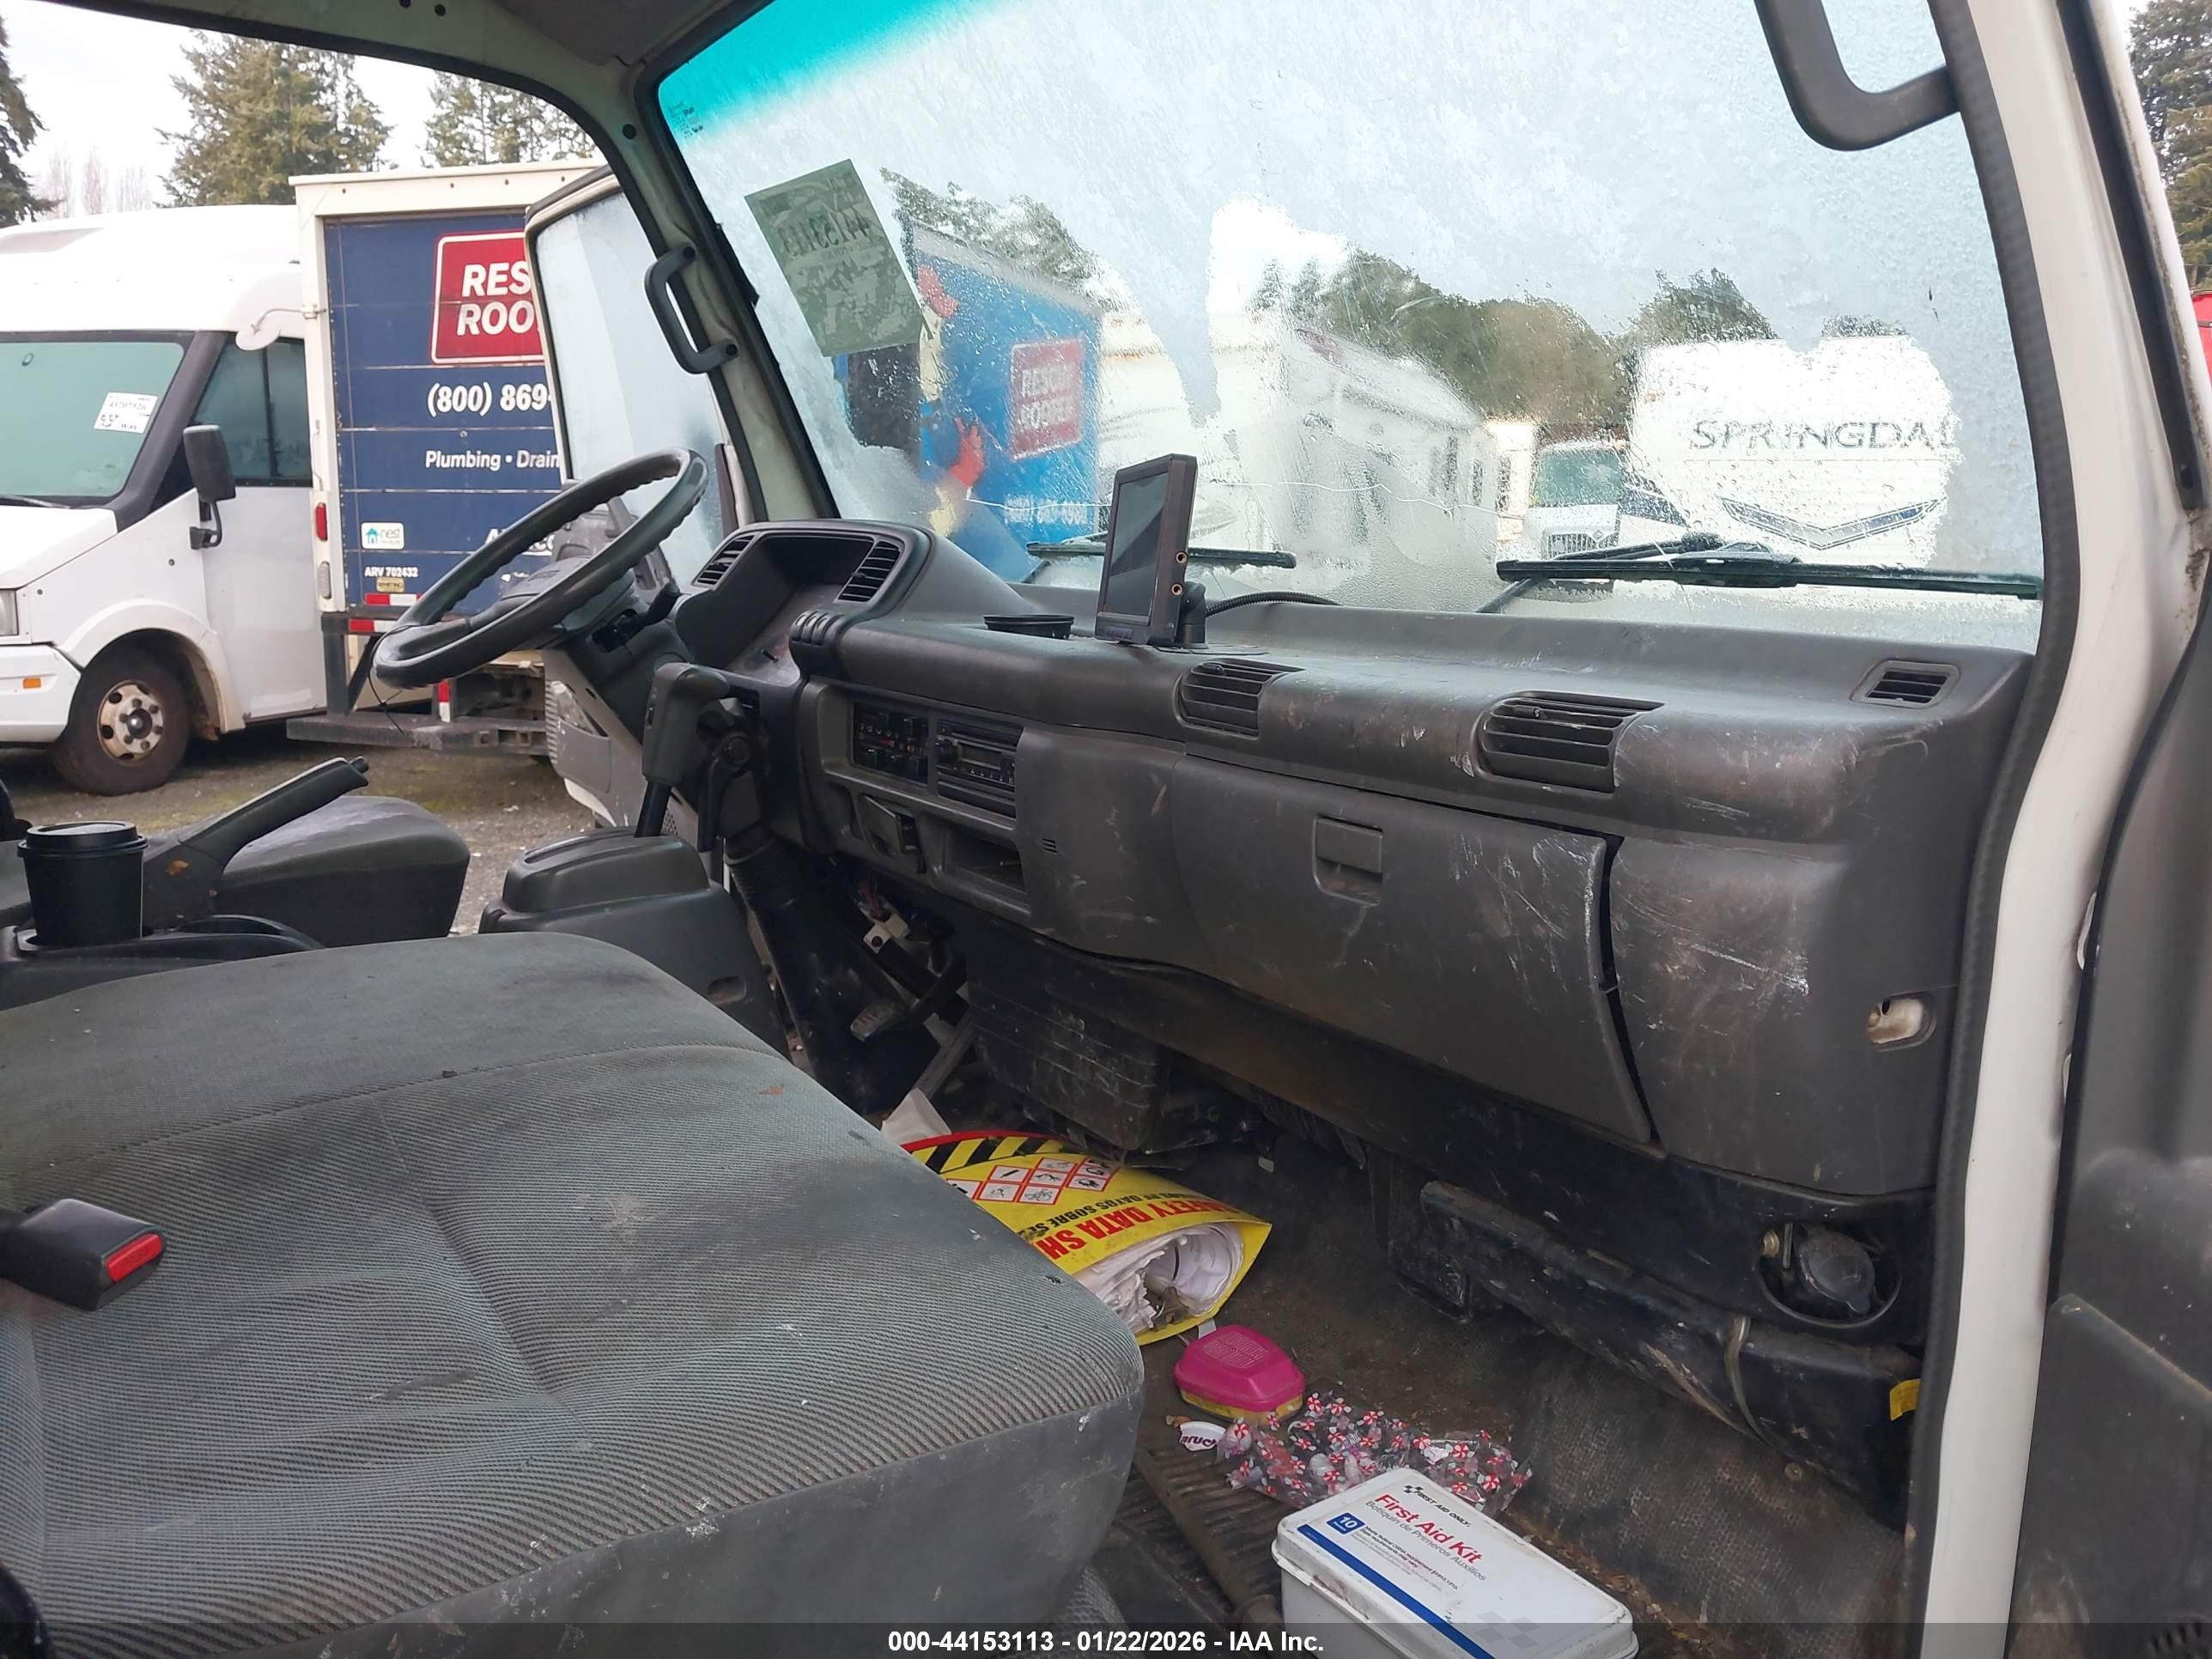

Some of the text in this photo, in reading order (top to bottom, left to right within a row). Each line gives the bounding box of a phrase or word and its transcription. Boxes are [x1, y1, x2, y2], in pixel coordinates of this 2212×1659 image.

[461, 260, 532, 298] RES
[428, 381, 493, 418] (800)
[425, 450, 501, 472] Plumbing
[364, 566, 384, 578] ARV
[1048, 1206, 1097, 1228] SOBRE
[1075, 1206, 1155, 1240] DATA
[1033, 1229, 1088, 1261] SH
[1338, 1516, 1358, 1529] 10
[1374, 1493, 1483, 1565] First Aid Kit
[1399, 1522, 1413, 1533] de
[1411, 1531, 1452, 1559] Primeros
[1449, 1556, 1487, 1582] Auxilios
